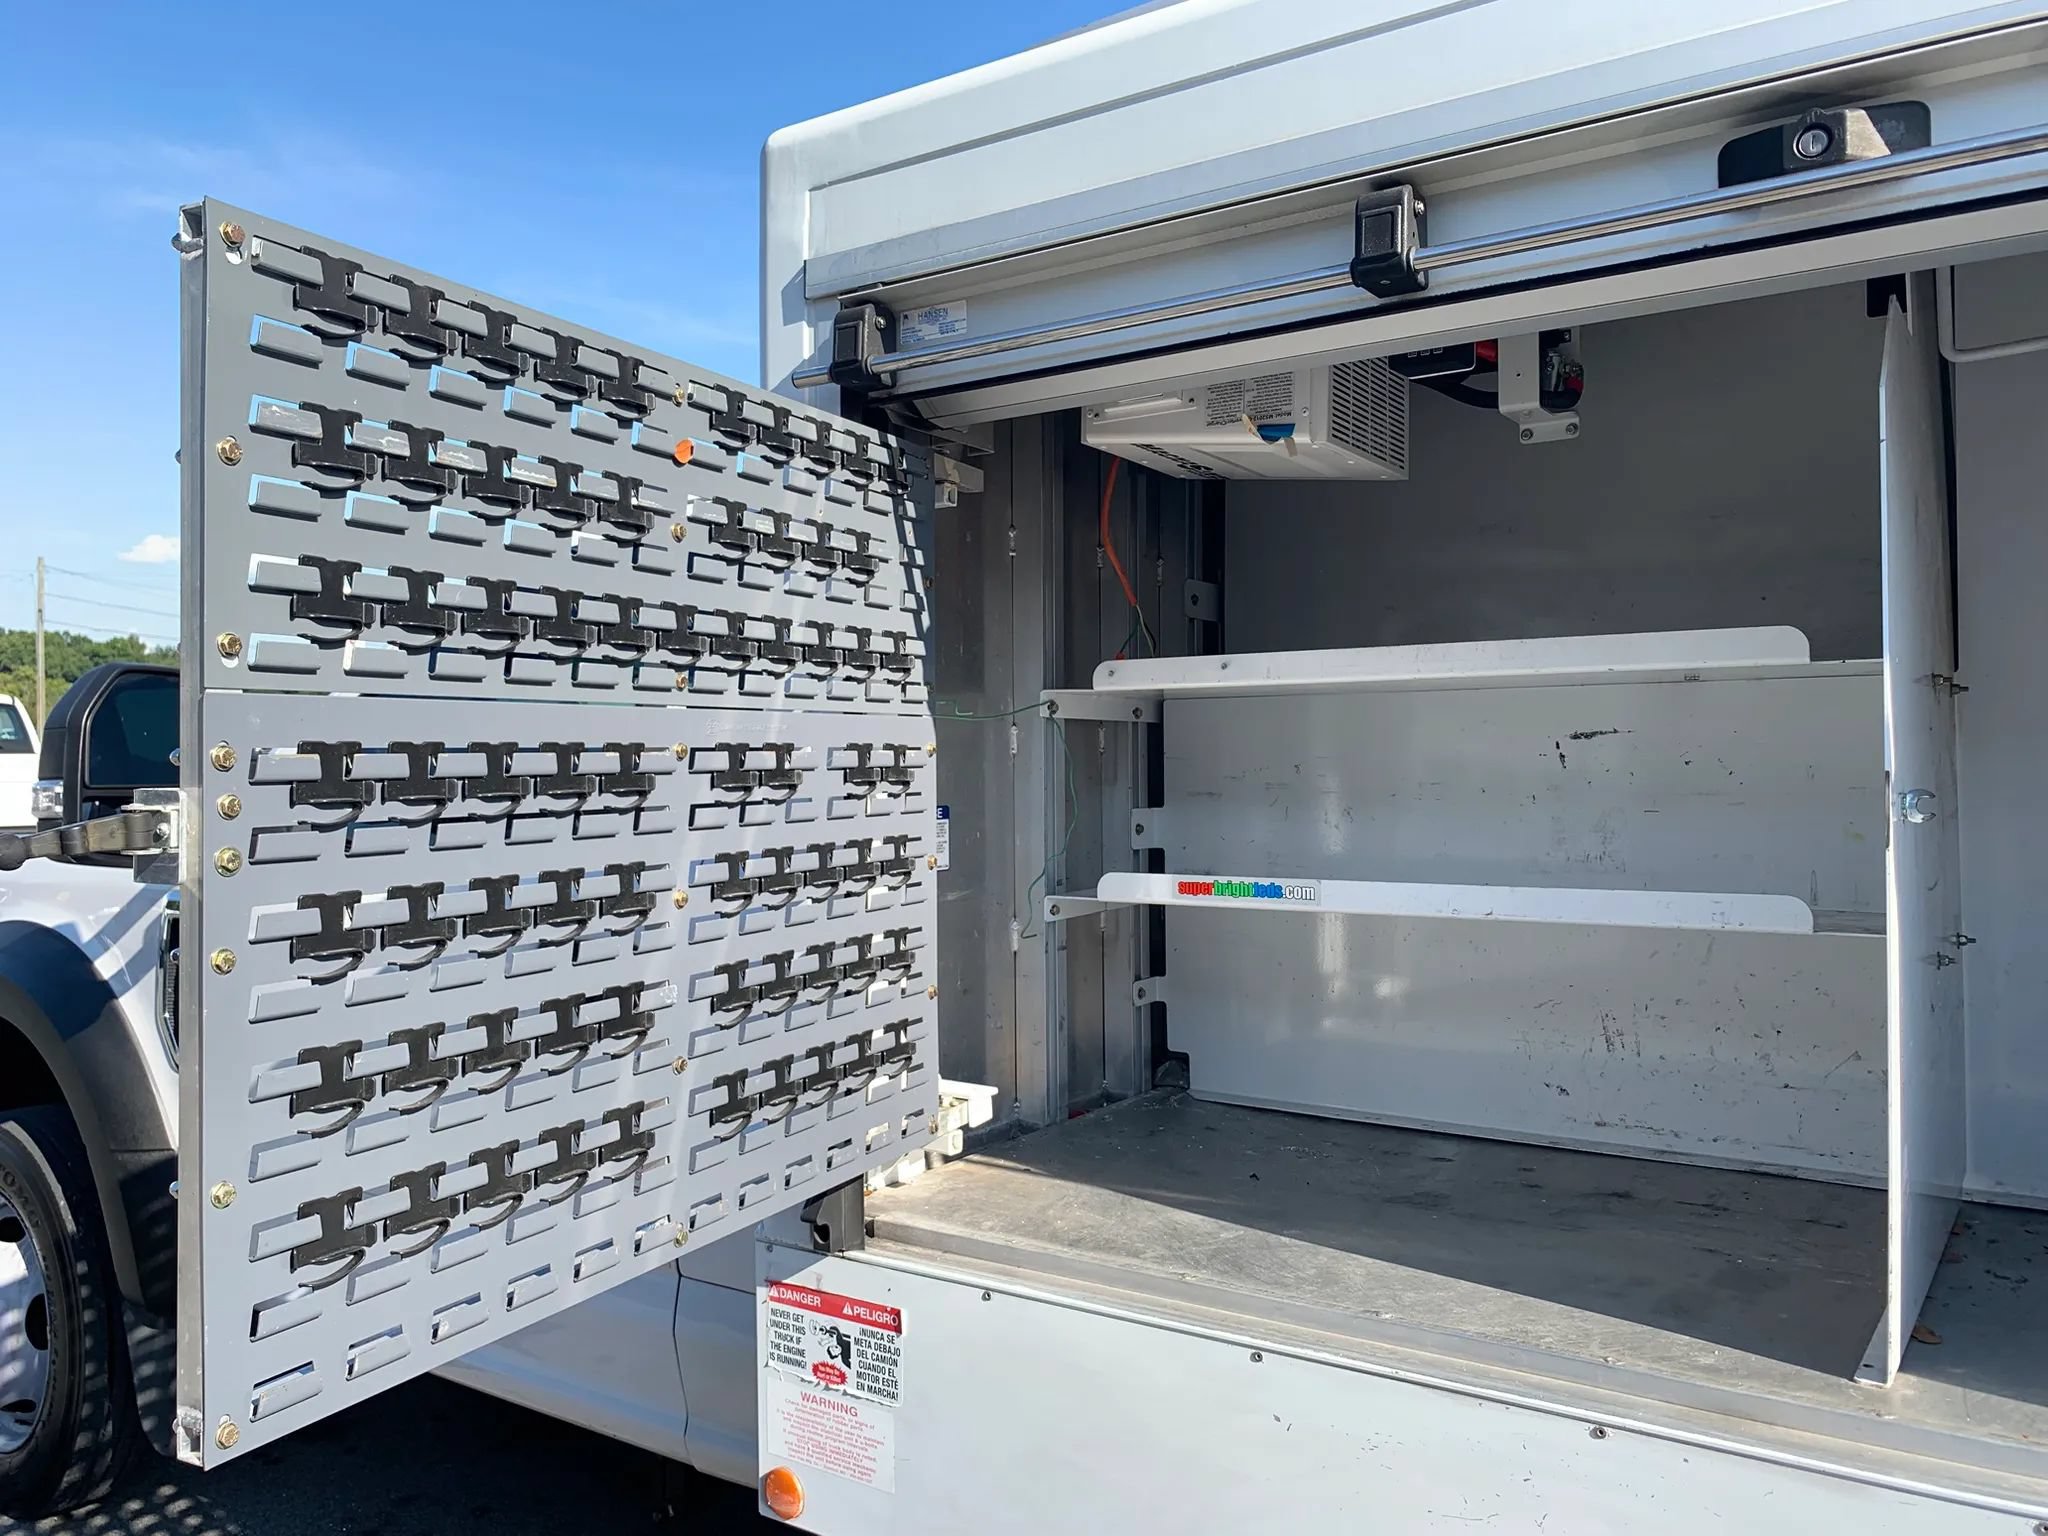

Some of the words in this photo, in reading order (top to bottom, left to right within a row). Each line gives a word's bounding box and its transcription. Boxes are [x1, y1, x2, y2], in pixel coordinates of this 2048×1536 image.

[1177, 880, 1316, 900] superbrightleds.com
[780, 1287, 822, 1307] DANGER
[770, 1308, 791, 1320] NEVER
[792, 1313, 804, 1324] GET
[853, 1305, 899, 1326] PELIGRO
[769, 1319, 791, 1331] UNDER
[791, 1324, 806, 1336] THIS
[774, 1330, 795, 1344] TRUCK
[796, 1337, 802, 1345] IF
[853, 1336, 872, 1349] META
[873, 1342, 901, 1357] DEBAJO
[886, 1334, 895, 1344] SE
[770, 1340, 782, 1352] THE
[783, 1345, 806, 1359] ENGINE
[856, 1348, 869, 1360] DEL
[870, 1351, 898, 1367] CAMIÓN
[769, 1351, 776, 1361] IS
[776, 1353, 808, 1370] RUNNING!
[858, 1359, 886, 1375] CUANDO
[888, 1368, 896, 1379] EL
[856, 1370, 880, 1385] MOTOR
[881, 1376, 899, 1391] ESTÉ
[856, 1381, 866, 1392] EN
[867, 1384, 899, 1401] MARCHA!
[800, 1391, 858, 1417] WARNING
